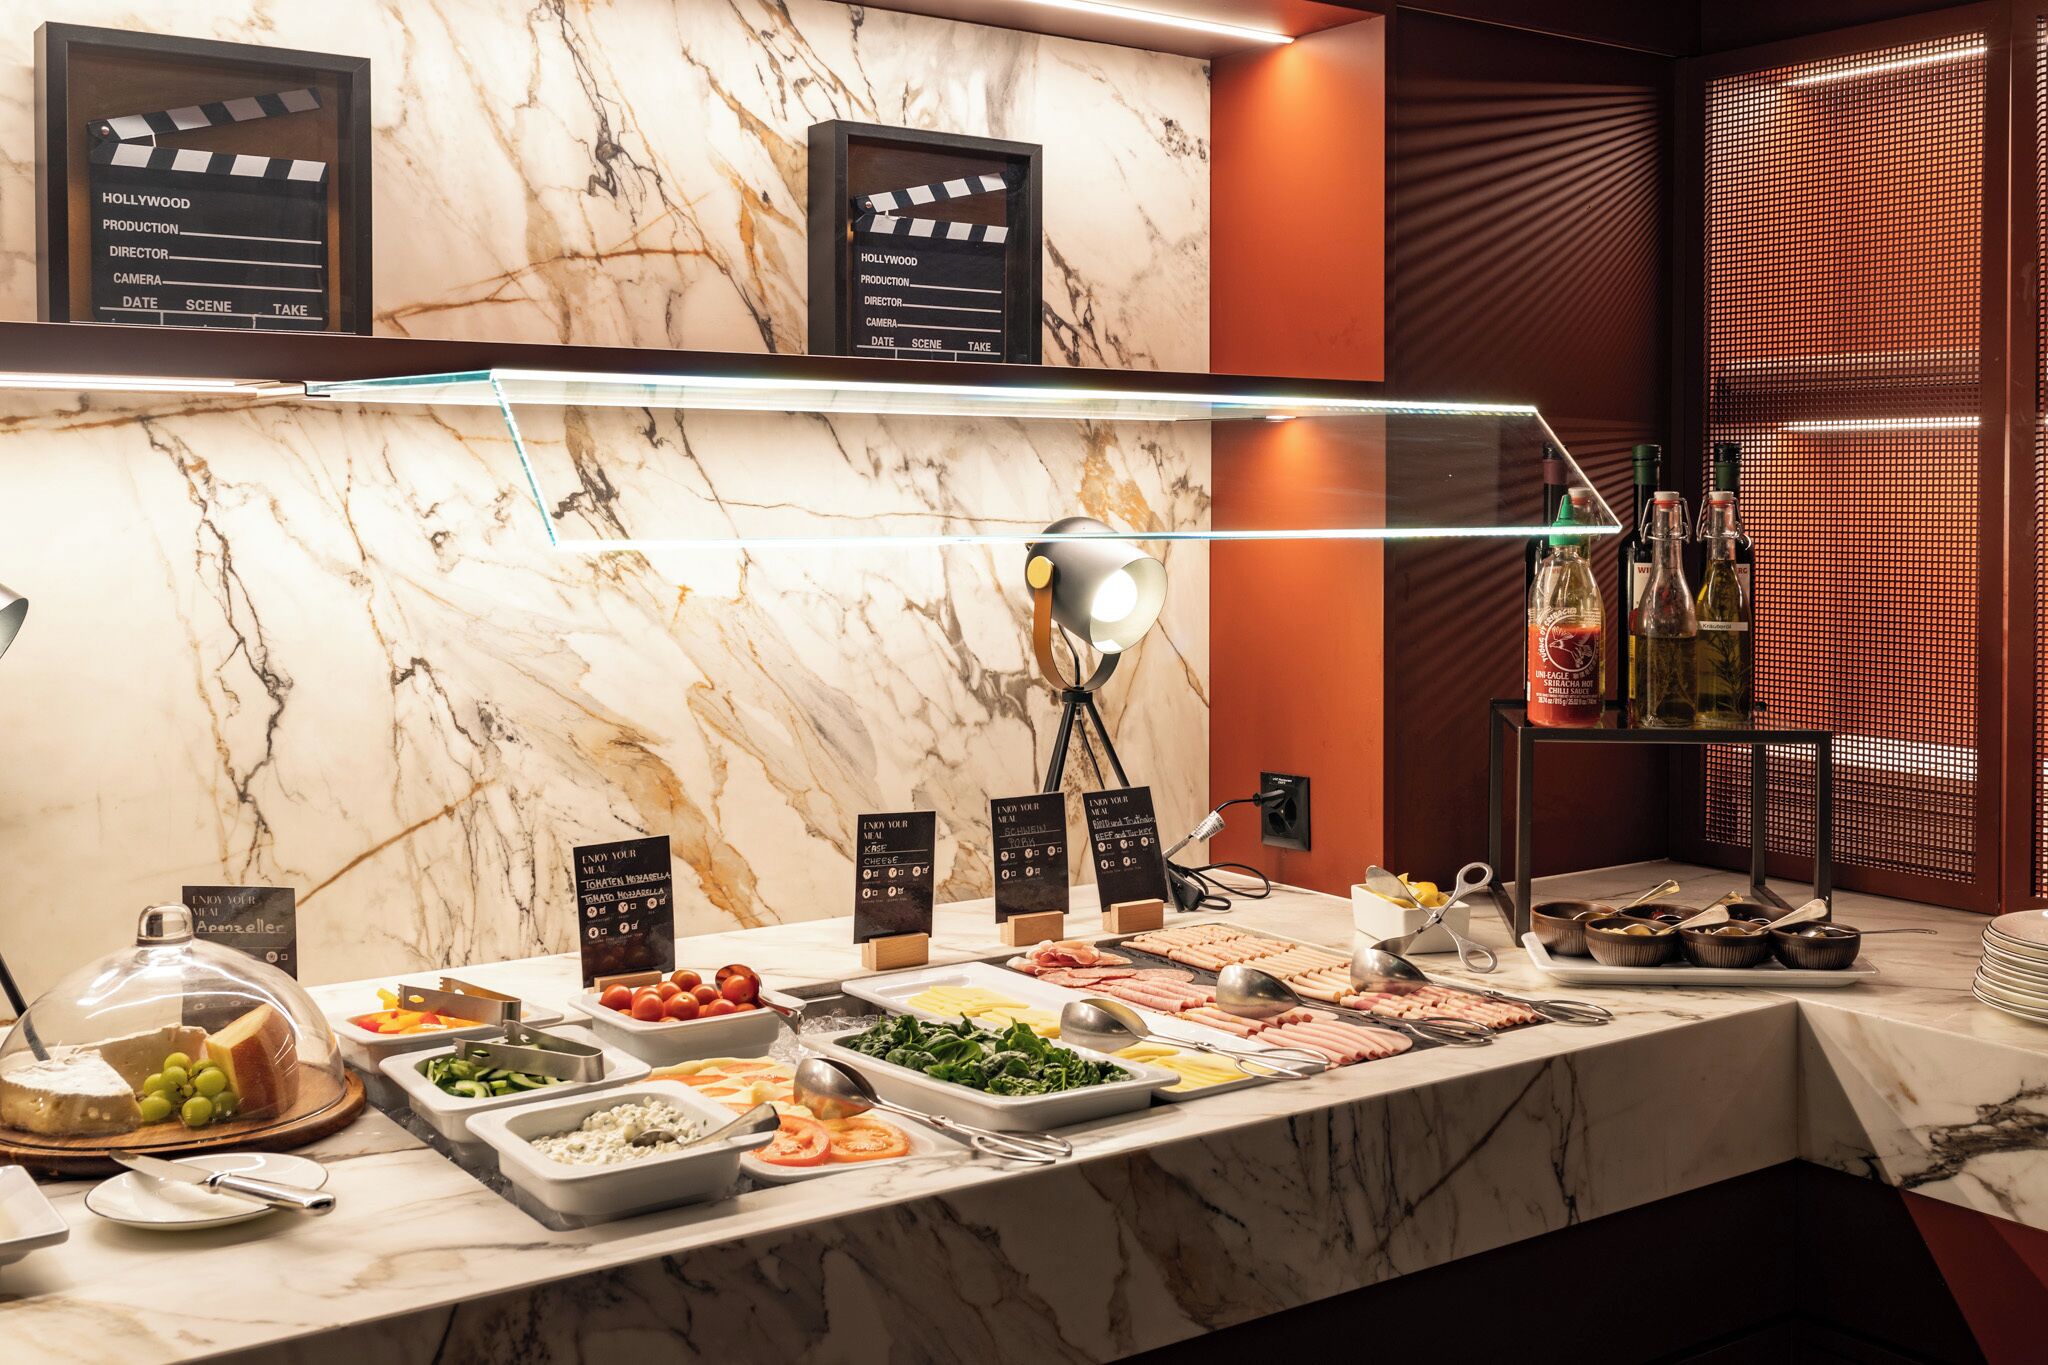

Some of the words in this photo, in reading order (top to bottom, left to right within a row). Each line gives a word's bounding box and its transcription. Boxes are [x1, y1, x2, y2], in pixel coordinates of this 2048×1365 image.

[102, 192, 191, 209] HOLLYWOOD
[102, 218, 179, 235] PRODUCTION
[109, 245, 169, 260] DIRECTOR
[861, 253, 918, 266] HOLLYWOOD
[113, 272, 162, 286] CAMERA
[860, 274, 910, 287] PRODUCTION
[122, 296, 158, 309] DATE
[185, 299, 232, 313] SCENE
[273, 303, 308, 317] TAKE
[864, 295, 903, 307] DIRECTOR
[866, 317, 897, 328] CAMERA
[871, 336, 895, 347] DATE
[911, 338, 942, 349] SCENE
[968, 341, 991, 352] TAKE
[1535, 670, 1570, 680] UNI-EAGLE
[1543, 679, 1580, 688] SRIRACHA
[1581, 680, 1593, 688] HOT
[1548, 687, 1569, 695] CHILLI
[1089, 799, 1108, 807] ENJOY
[1110, 796, 1129, 805] YOUR
[997, 805, 1017, 814] ENJOY
[1020, 802, 1039, 812] YOUR
[1091, 808, 1108, 816] MEAL
[863, 821, 885, 830] ENJOY
[888, 820, 908, 829] YOUR
[998, 815, 1016, 824] MEAL
[863, 831, 882, 840] MEAL
[1004, 824, 1047, 837] SCHWEIN
[1095, 831, 1114, 842] BEEF
[1114, 830, 1126, 839] and
[1008, 837, 1036, 848] PORK
[582, 852, 608, 864] ENJOY
[612, 849, 636, 860] YOUR
[863, 855, 899, 865] CHEESE
[583, 865, 606, 875] MEAL
[192, 895, 222, 905] ENJOY
[227, 895, 256, 904] YOUR
[193, 907, 219, 917] MEAL
[196, 918, 285, 934] Apenzeller
